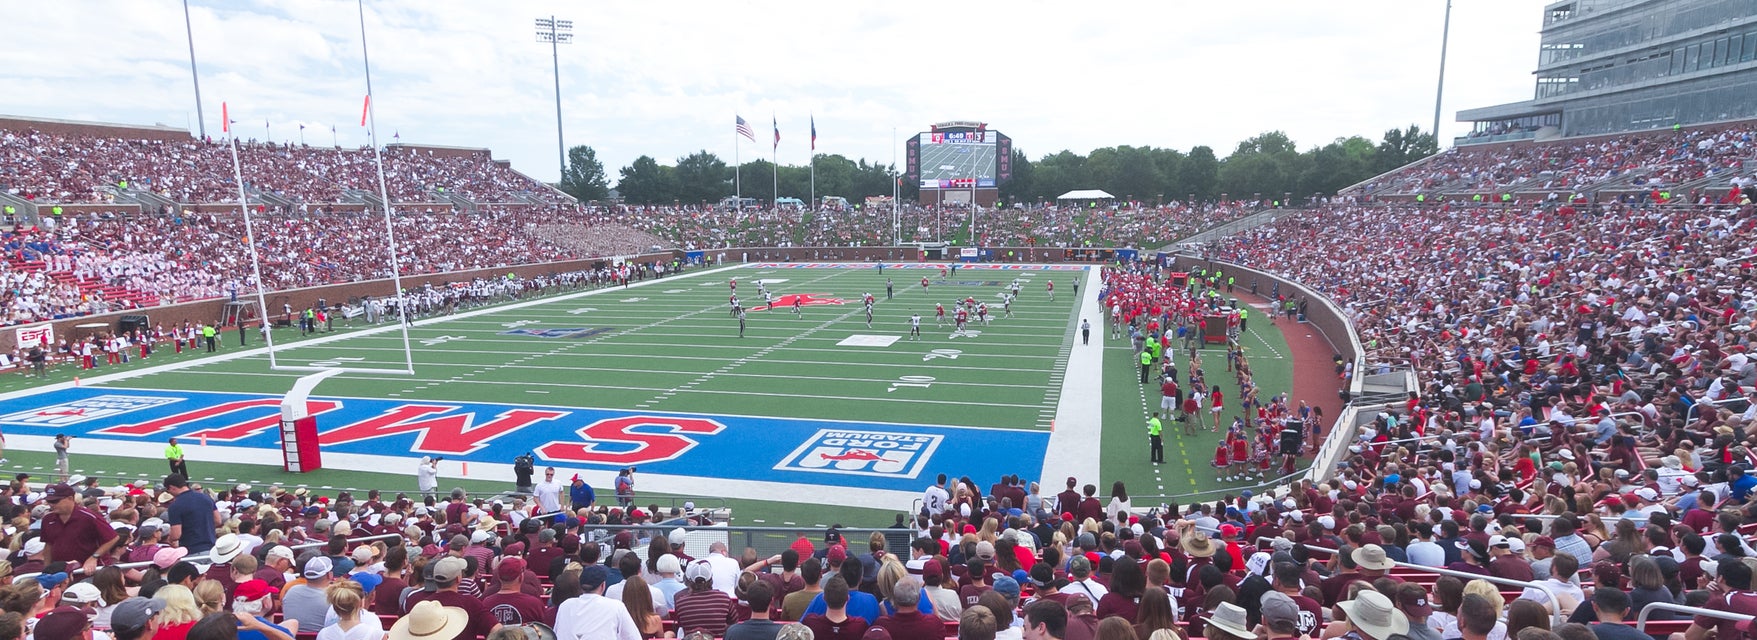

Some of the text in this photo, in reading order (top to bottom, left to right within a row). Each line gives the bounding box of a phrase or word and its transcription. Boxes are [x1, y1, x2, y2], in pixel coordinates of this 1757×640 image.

[891, 375, 936, 388] 10
[826, 431, 930, 443] STADIUM
[823, 438, 924, 451] FORD
[931, 495, 938, 508] 2
